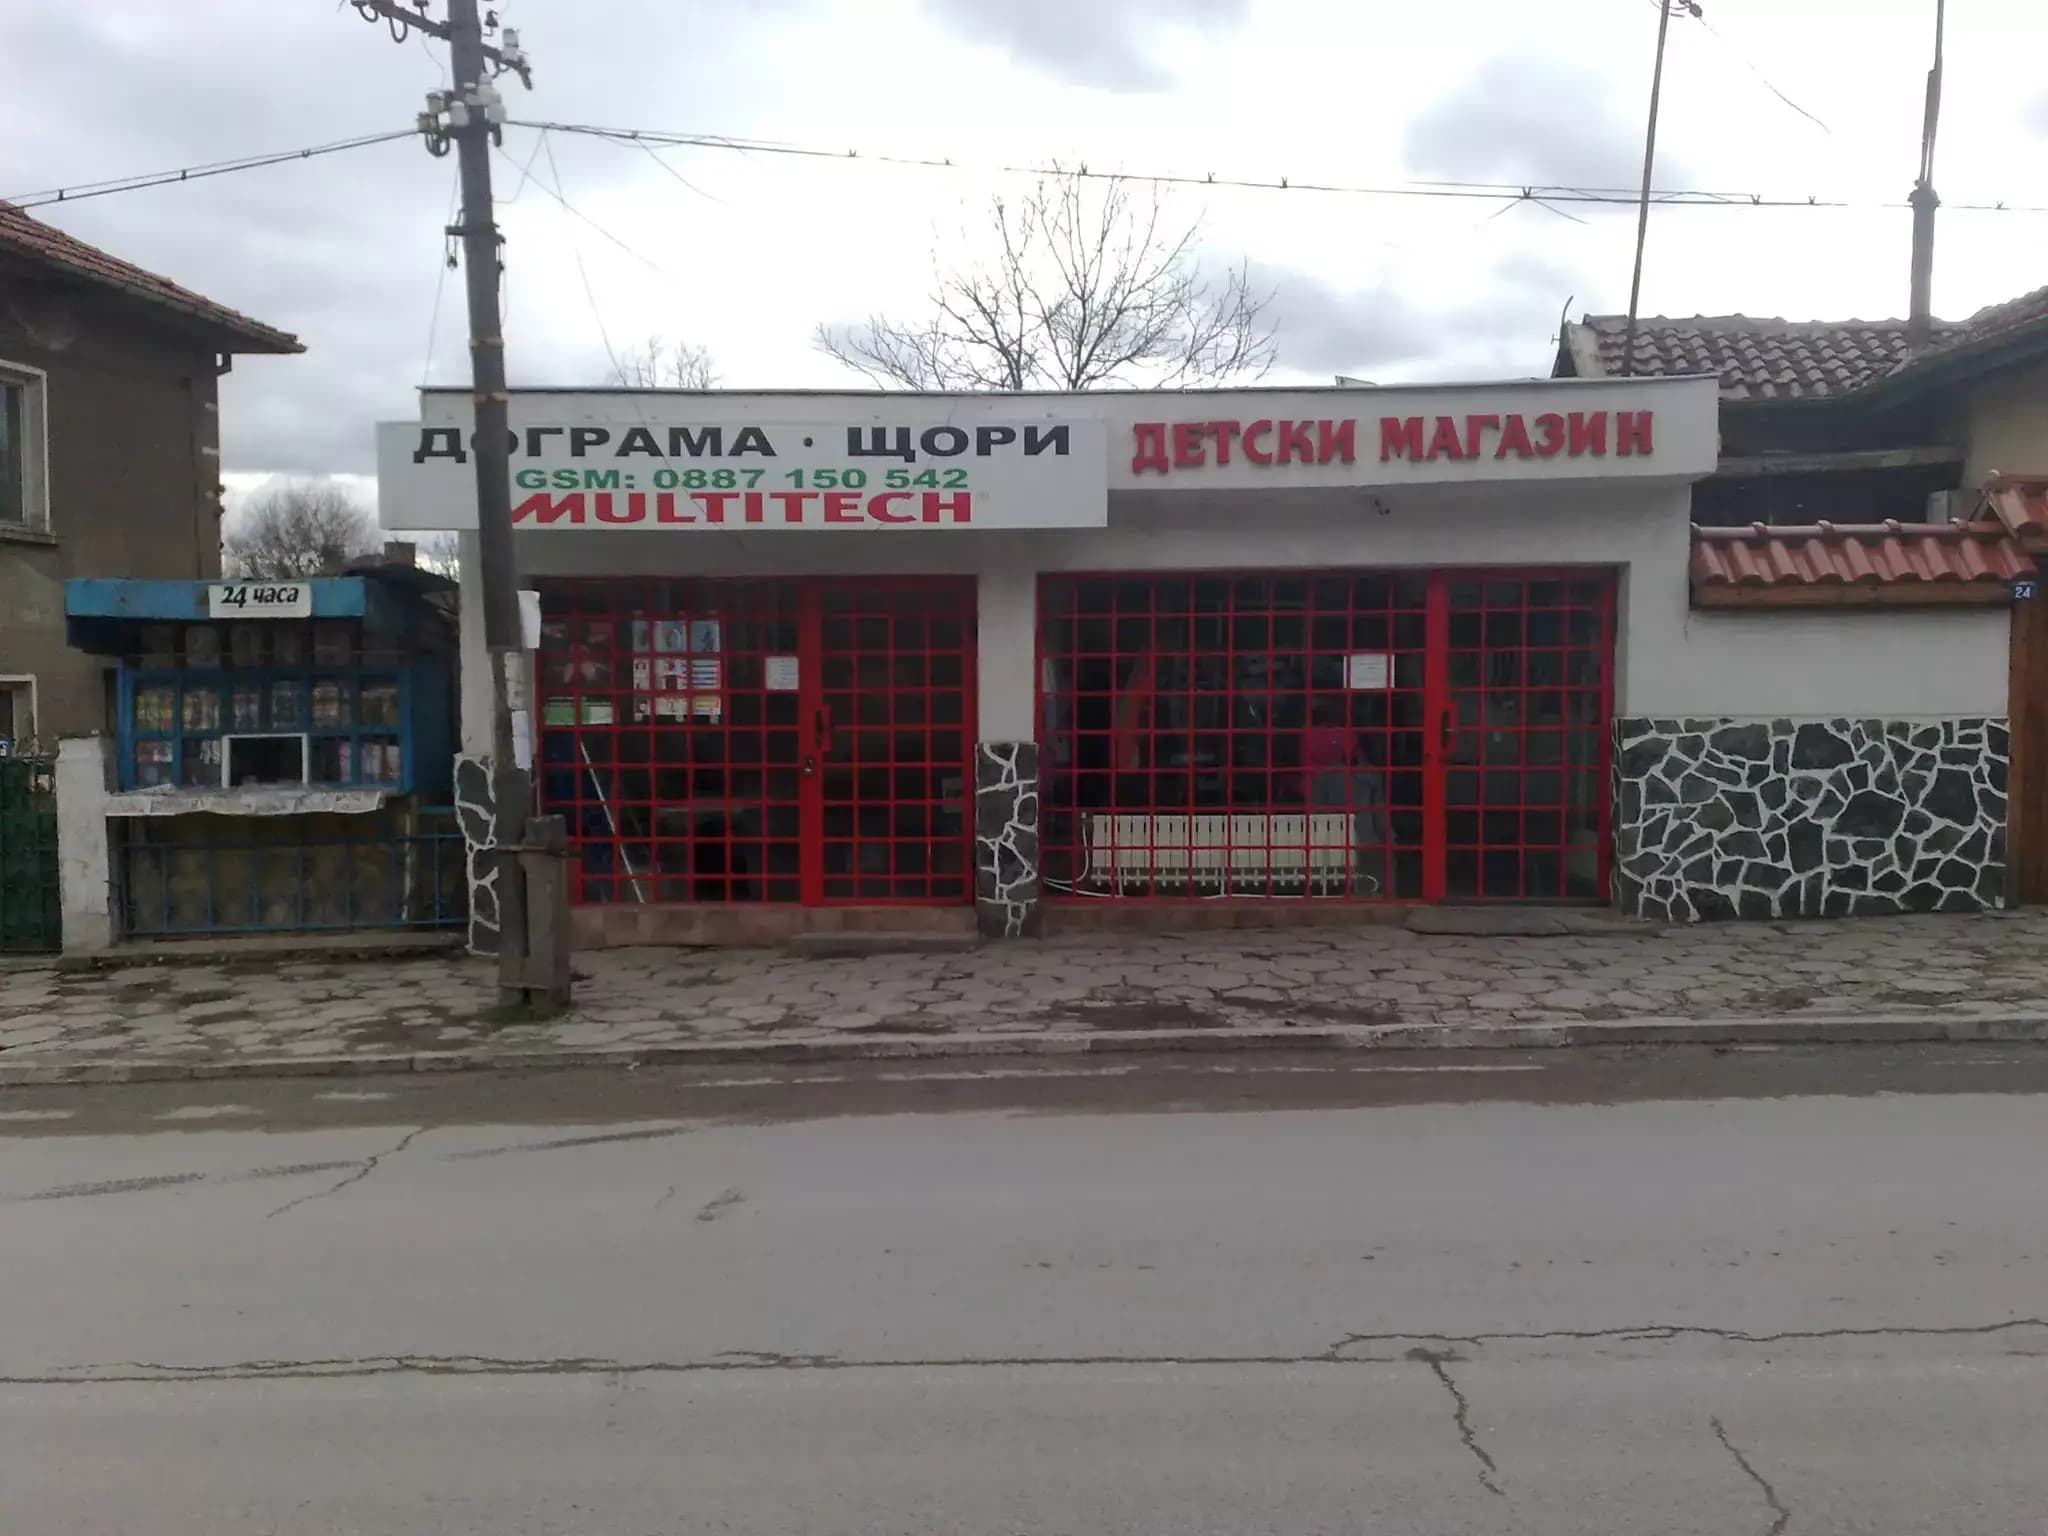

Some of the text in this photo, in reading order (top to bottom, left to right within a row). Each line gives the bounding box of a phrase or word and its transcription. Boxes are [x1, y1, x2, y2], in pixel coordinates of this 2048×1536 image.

[847, 426, 1070, 463] ЩОРИ
[1132, 411, 1654, 474] ДЕТСКИ МАГАЗИН
[515, 469, 969, 490] GSM: 0887 150 542
[511, 492, 972, 524] MULTITECH
[220, 585, 299, 608] 24 часа
